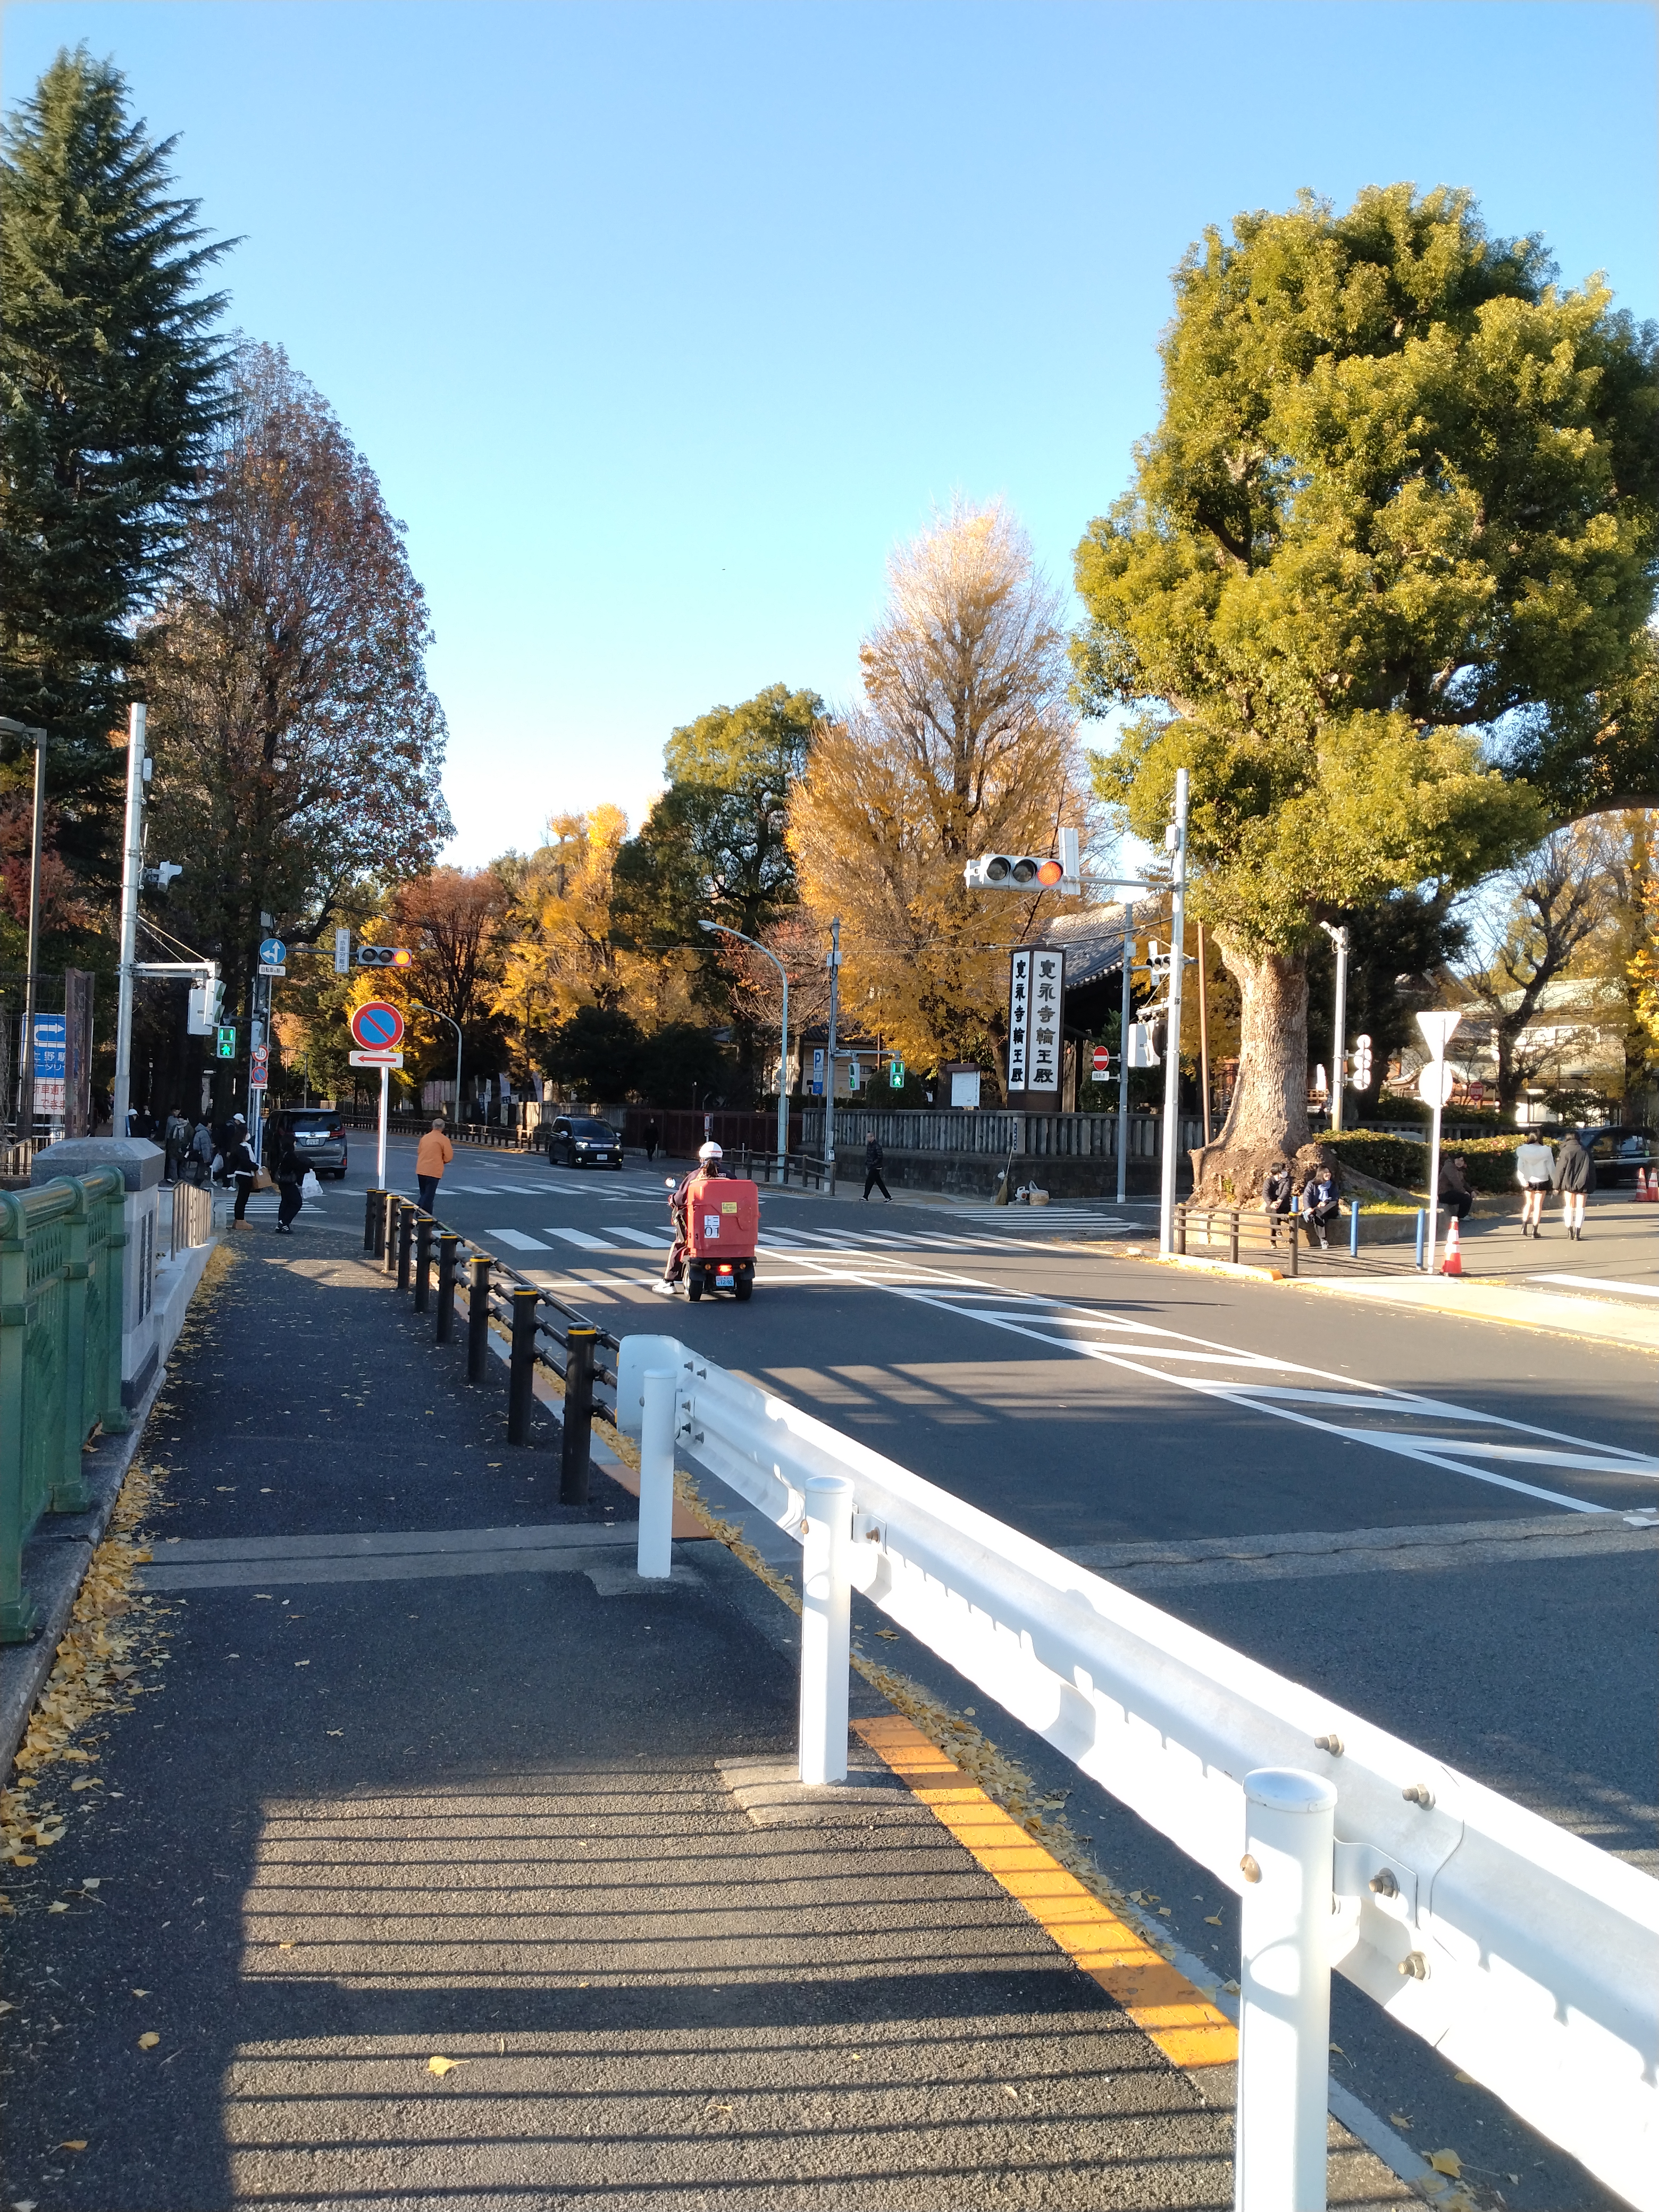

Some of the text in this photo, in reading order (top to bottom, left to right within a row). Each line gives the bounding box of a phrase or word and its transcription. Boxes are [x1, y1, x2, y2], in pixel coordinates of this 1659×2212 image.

[1033, 959, 1057, 1083] 寛永寺輪王殿
[815, 1052, 821, 1069] P
[705, 1226, 719, 1237] 01
